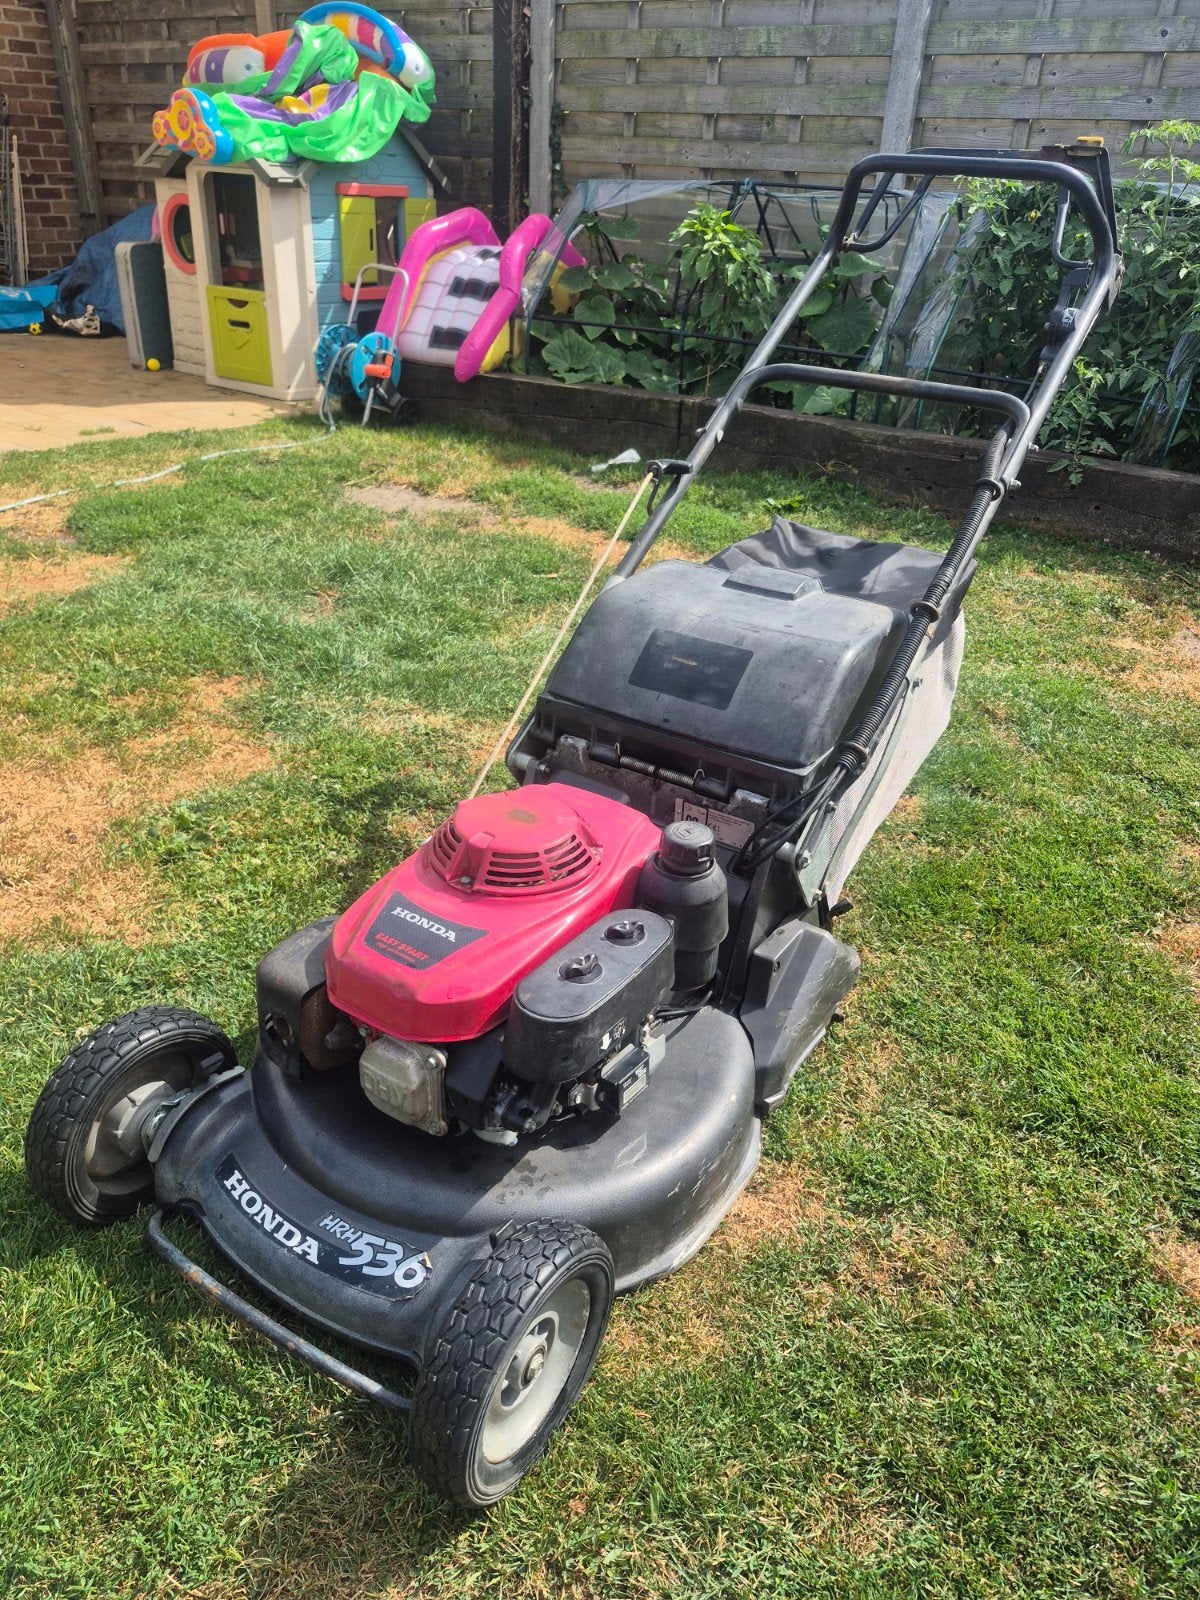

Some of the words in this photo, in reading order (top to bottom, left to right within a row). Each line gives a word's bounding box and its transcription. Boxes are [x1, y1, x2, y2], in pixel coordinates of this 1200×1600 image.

[390, 906, 456, 943] HONDA
[223, 1169, 320, 1265] HONDA
[338, 1232, 428, 1289] 536
